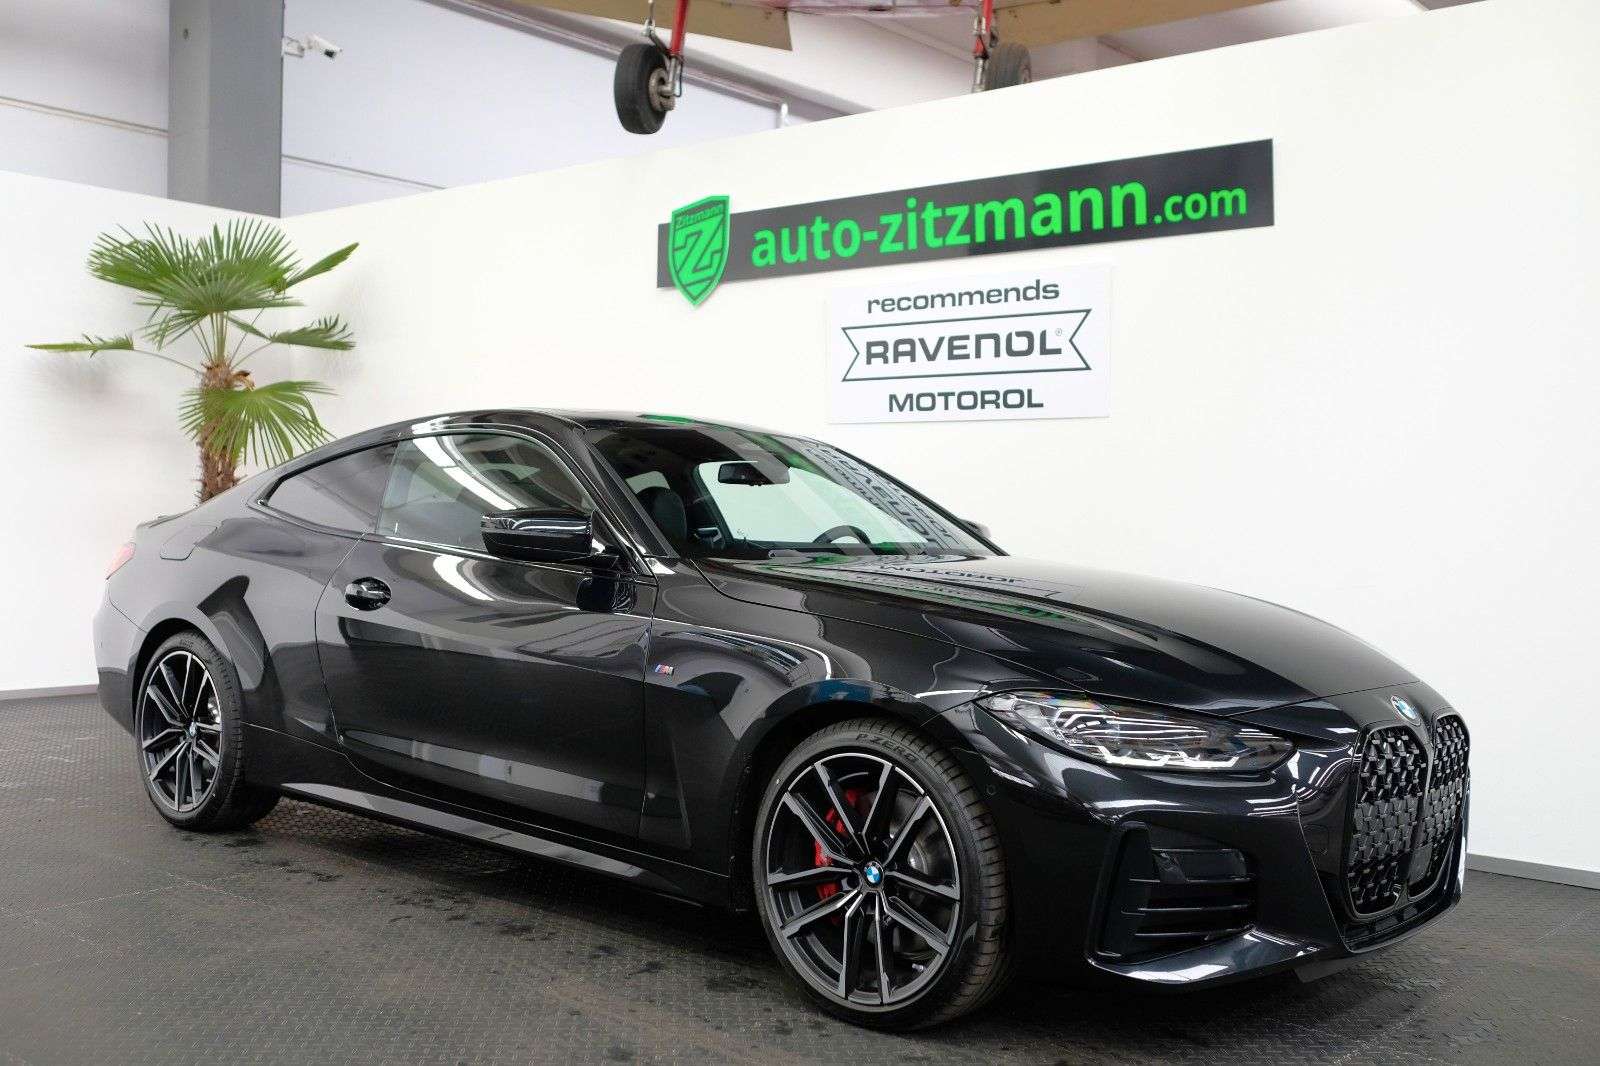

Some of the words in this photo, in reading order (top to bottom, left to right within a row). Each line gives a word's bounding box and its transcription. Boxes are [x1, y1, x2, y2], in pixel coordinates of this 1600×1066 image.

[751, 181, 1248, 268] auto-zitzmann.com
[867, 279, 1060, 314] recommends
[889, 388, 1044, 413] MOTOROL
